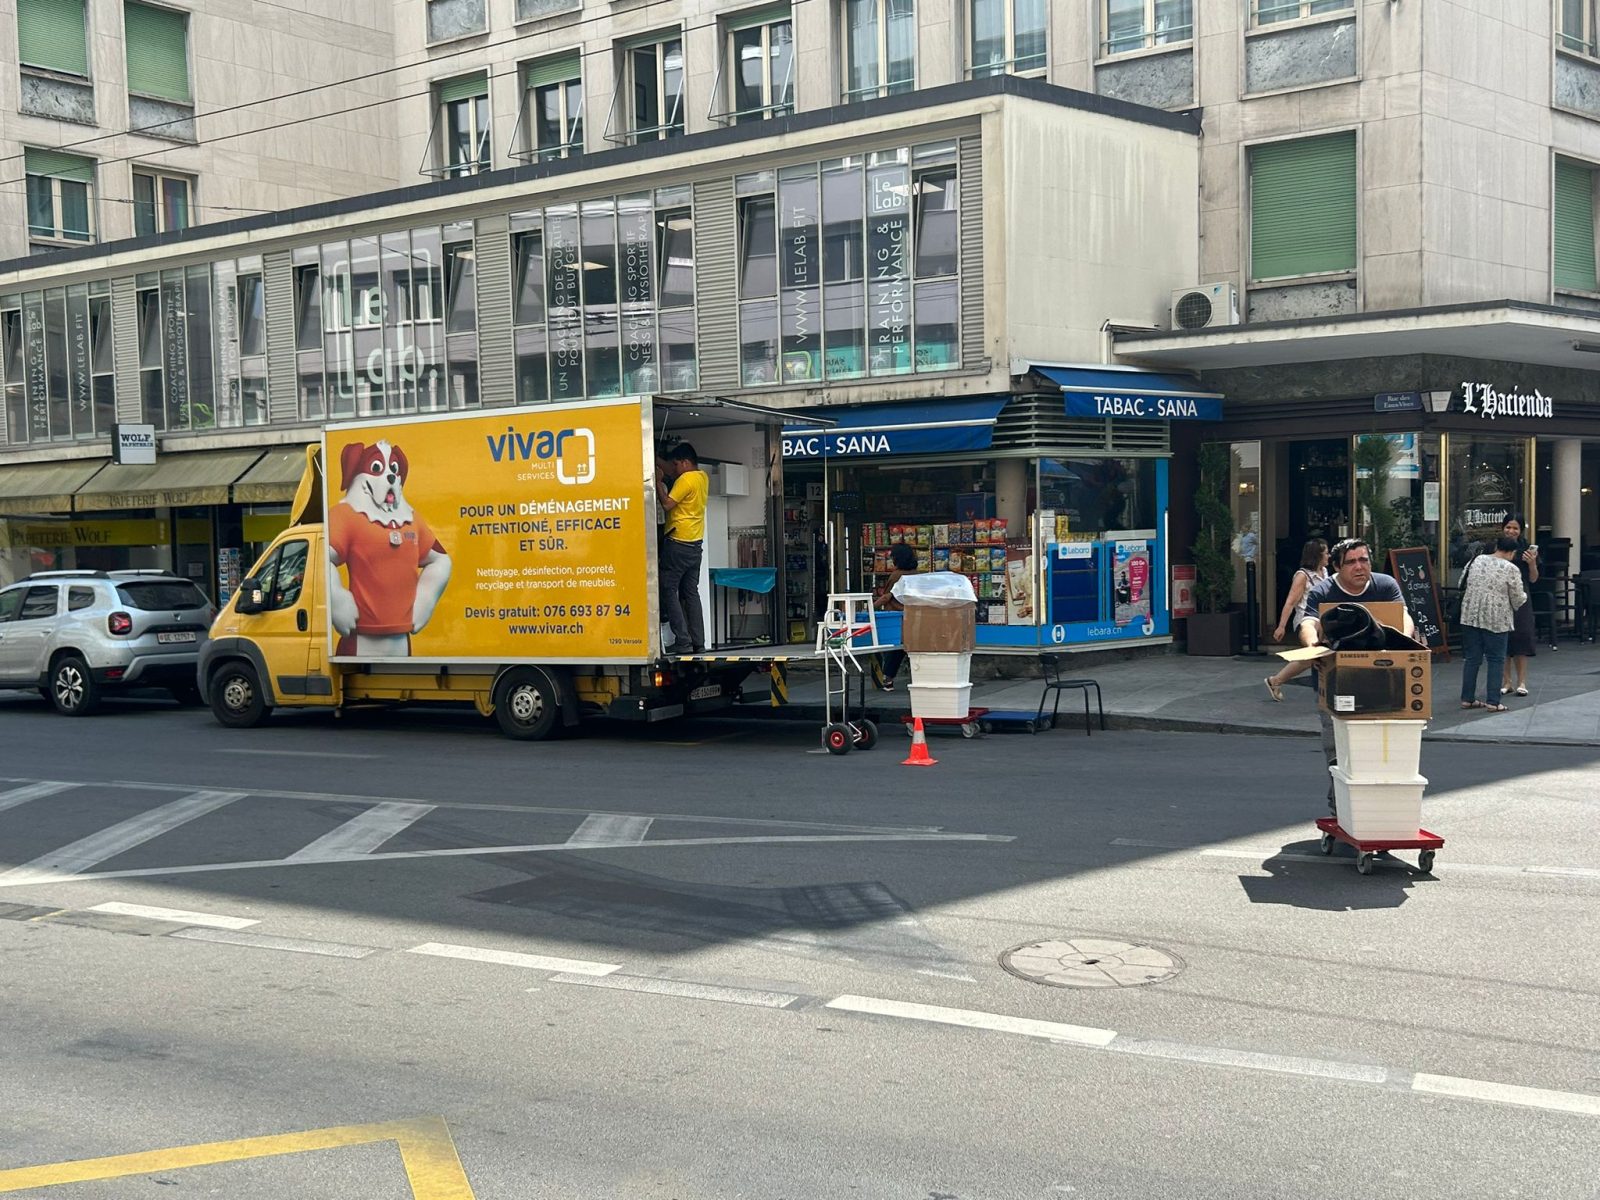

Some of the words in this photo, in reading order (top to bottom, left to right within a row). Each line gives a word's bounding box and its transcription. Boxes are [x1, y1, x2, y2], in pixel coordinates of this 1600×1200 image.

[876, 222, 889, 234] &
[626, 230, 637, 281] SPORTIF
[554, 273, 564, 291] DE
[793, 205, 808, 344] WWW.LELAB.FIT
[890, 219, 905, 354] PERFORMANCE
[877, 248, 891, 355] TRAINING
[555, 294, 568, 367] COACHING
[627, 286, 639, 361] COACHING
[568, 332, 579, 366] POUR
[36, 337, 47, 429] PERFORMANCE
[168, 343, 178, 404] COACHING
[559, 372, 569, 391] UN
[30, 356, 41, 430] TRAINING
[1461, 382, 1553, 420] L'Hacienda
[1093, 396, 1145, 416] TABAC
[1157, 399, 1198, 417] SANA
[120, 433, 152, 442] WOLF
[486, 426, 575, 463] vivar
[781, 438, 820, 456] BAC
[836, 434, 891, 454] SANA
[517, 471, 556, 481] SERVICES
[531, 461, 555, 471] MULTI
[810, 486, 822, 497] 12
[460, 504, 494, 518] POUR
[498, 503, 516, 516] UN
[519, 497, 631, 516] DÉMÉNAGEMENT
[74, 526, 112, 545] WOLF
[469, 518, 553, 536] ATTENTIONÉ,
[556, 517, 621, 532] EFFICACE
[519, 539, 535, 552] ET
[539, 535, 568, 551] SÛR.
[1067, 546, 1090, 555] Lebara
[476, 567, 521, 578] Nettoyage,
[522, 565, 575, 576] désinfection,
[576, 564, 616, 576] propreté,
[475, 581, 514, 591] recyclage
[516, 580, 525, 589] et
[526, 580, 565, 590] transport
[566, 578, 578, 588] de
[579, 577, 617, 588] meubles.
[465, 606, 495, 618] Devis
[499, 605, 540, 620] gratuit:
[543, 605, 566, 617] 076
[569, 604, 592, 617] 693
[596, 604, 610, 617] 87
[614, 604, 631, 617] 94
[508, 622, 584, 635] www.vivar.ch
